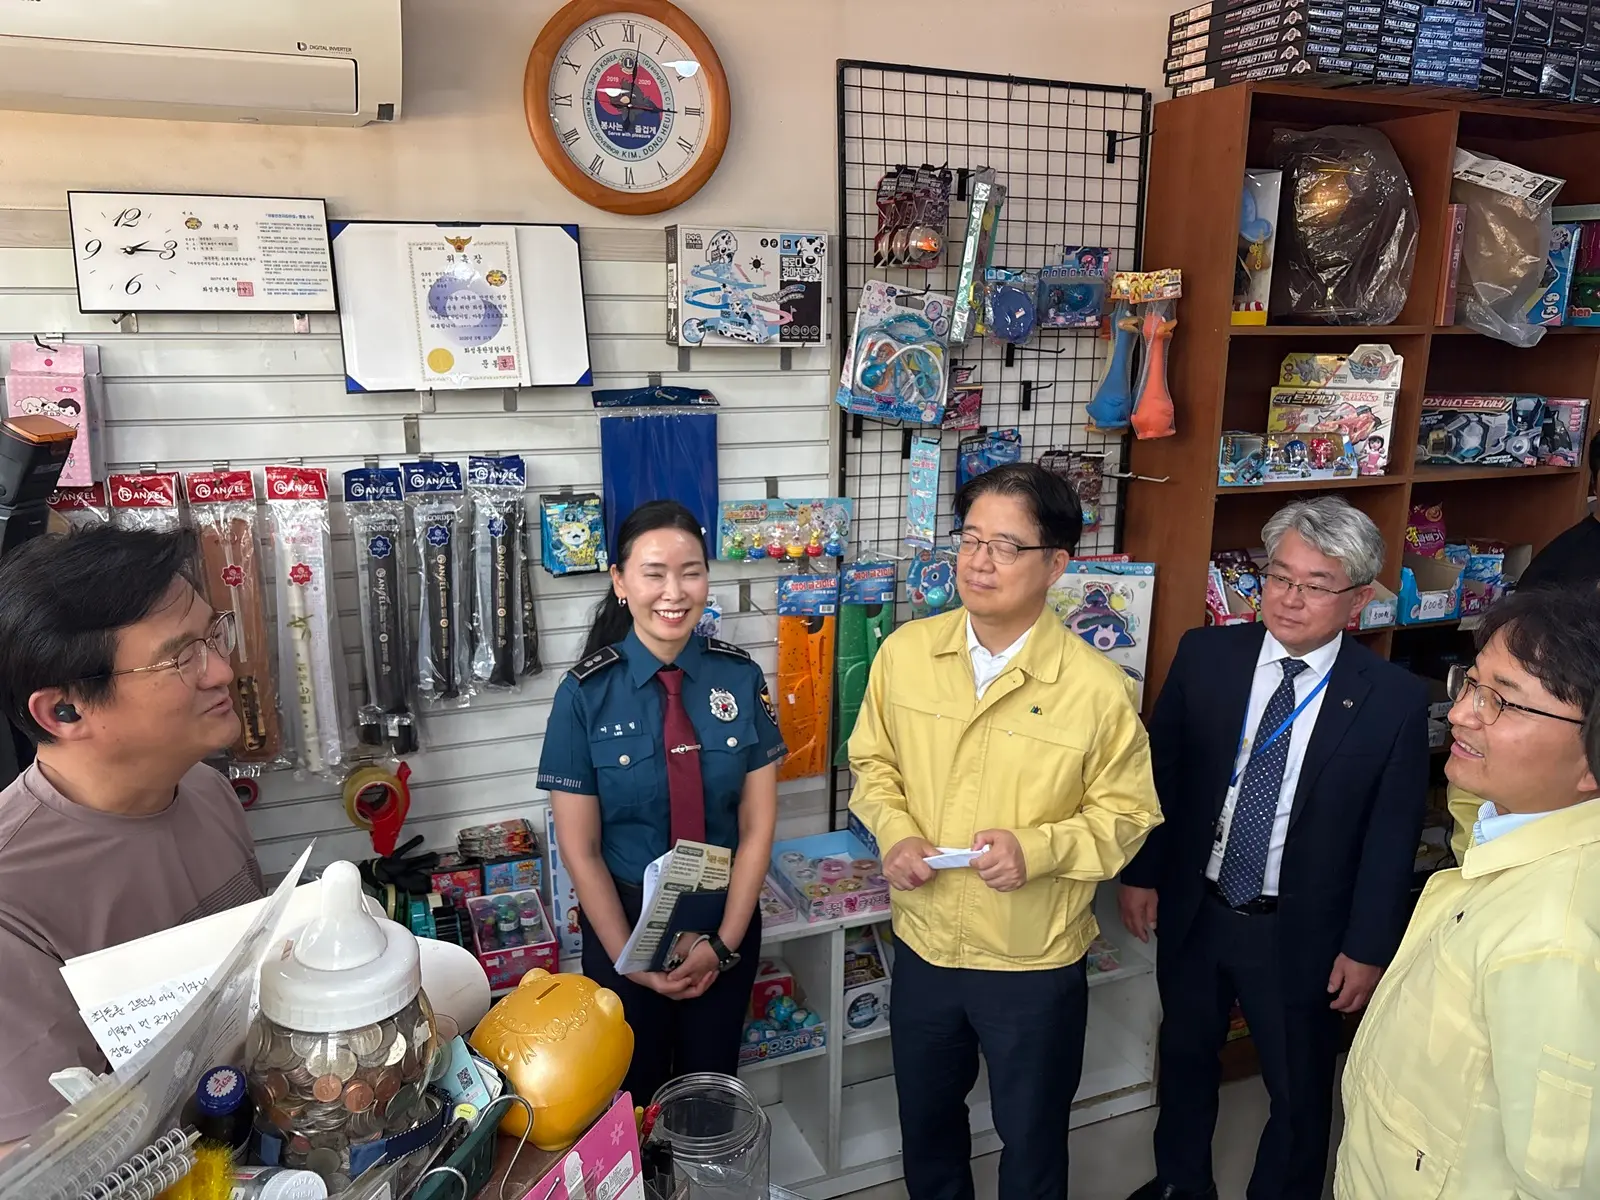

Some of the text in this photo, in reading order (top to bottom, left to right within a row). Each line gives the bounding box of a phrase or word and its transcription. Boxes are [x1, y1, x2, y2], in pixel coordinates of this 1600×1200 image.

[1349, 5, 1380, 13] CHALLENGER
[1310, 25, 1342, 35] CHALLENGER
[1347, 22, 1379, 30] CHALLENGER
[1385, 19, 1416, 28] CHALLENGER
[586, 28, 605, 51] XI
[622, 24, 635, 43] XII
[1381, 36, 1412, 45] CHALLENGER
[1307, 43, 1340, 54] CHALLENGER
[600, 54, 618, 70] KOREA
[1379, 54, 1410, 63] CHALLENGER
[1377, 71, 1409, 80] CHALLENGER
[554, 93, 572, 108] IX
[684, 106, 701, 116] III
[586, 107, 619, 155] DISTRICT GOVERNOR
[601, 121, 656, 135] 봉사는 즐겁게
[643, 136, 663, 155] DONG
[661, 113, 672, 136] HEUI
[112, 207, 142, 228] 12
[83, 239, 102, 260] 9
[159, 240, 178, 260] 3
[1041, 268, 1105, 278] ROBOTEX
[125, 273, 144, 295] 6
